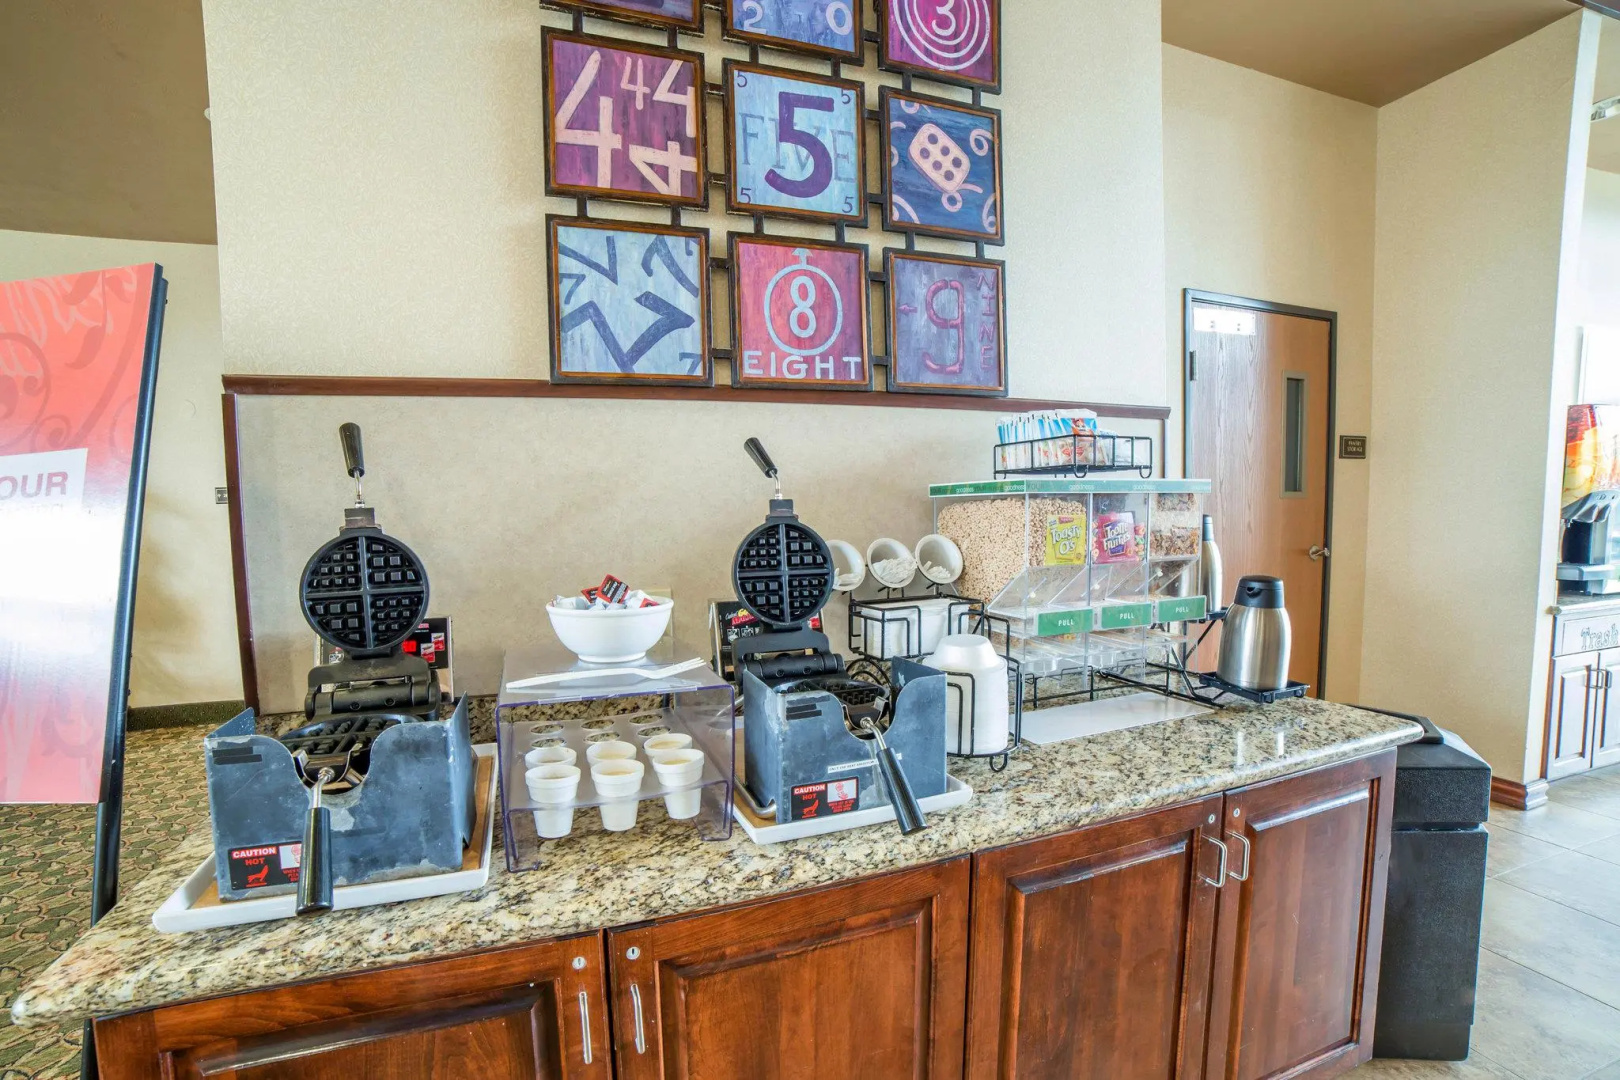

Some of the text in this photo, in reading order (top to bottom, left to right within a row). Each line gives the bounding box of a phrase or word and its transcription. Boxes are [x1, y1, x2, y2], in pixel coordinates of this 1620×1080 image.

[743, 0, 767, 35] 2
[931, 0, 957, 36] 3
[620, 56, 651, 111] 4
[555, 50, 622, 188] 4
[764, 91, 835, 199] 5
[841, 196, 854, 214] 5
[789, 275, 817, 338] 8
[922, 278, 965, 374] 9
[743, 350, 862, 380] EIGHT
[1581, 623, 1619, 650] Trash
[794, 784, 826, 795] CAUTION
[802, 793, 817, 801] HOT
[232, 847, 277, 859] CAUTION
[245, 858, 265, 866] HOT
